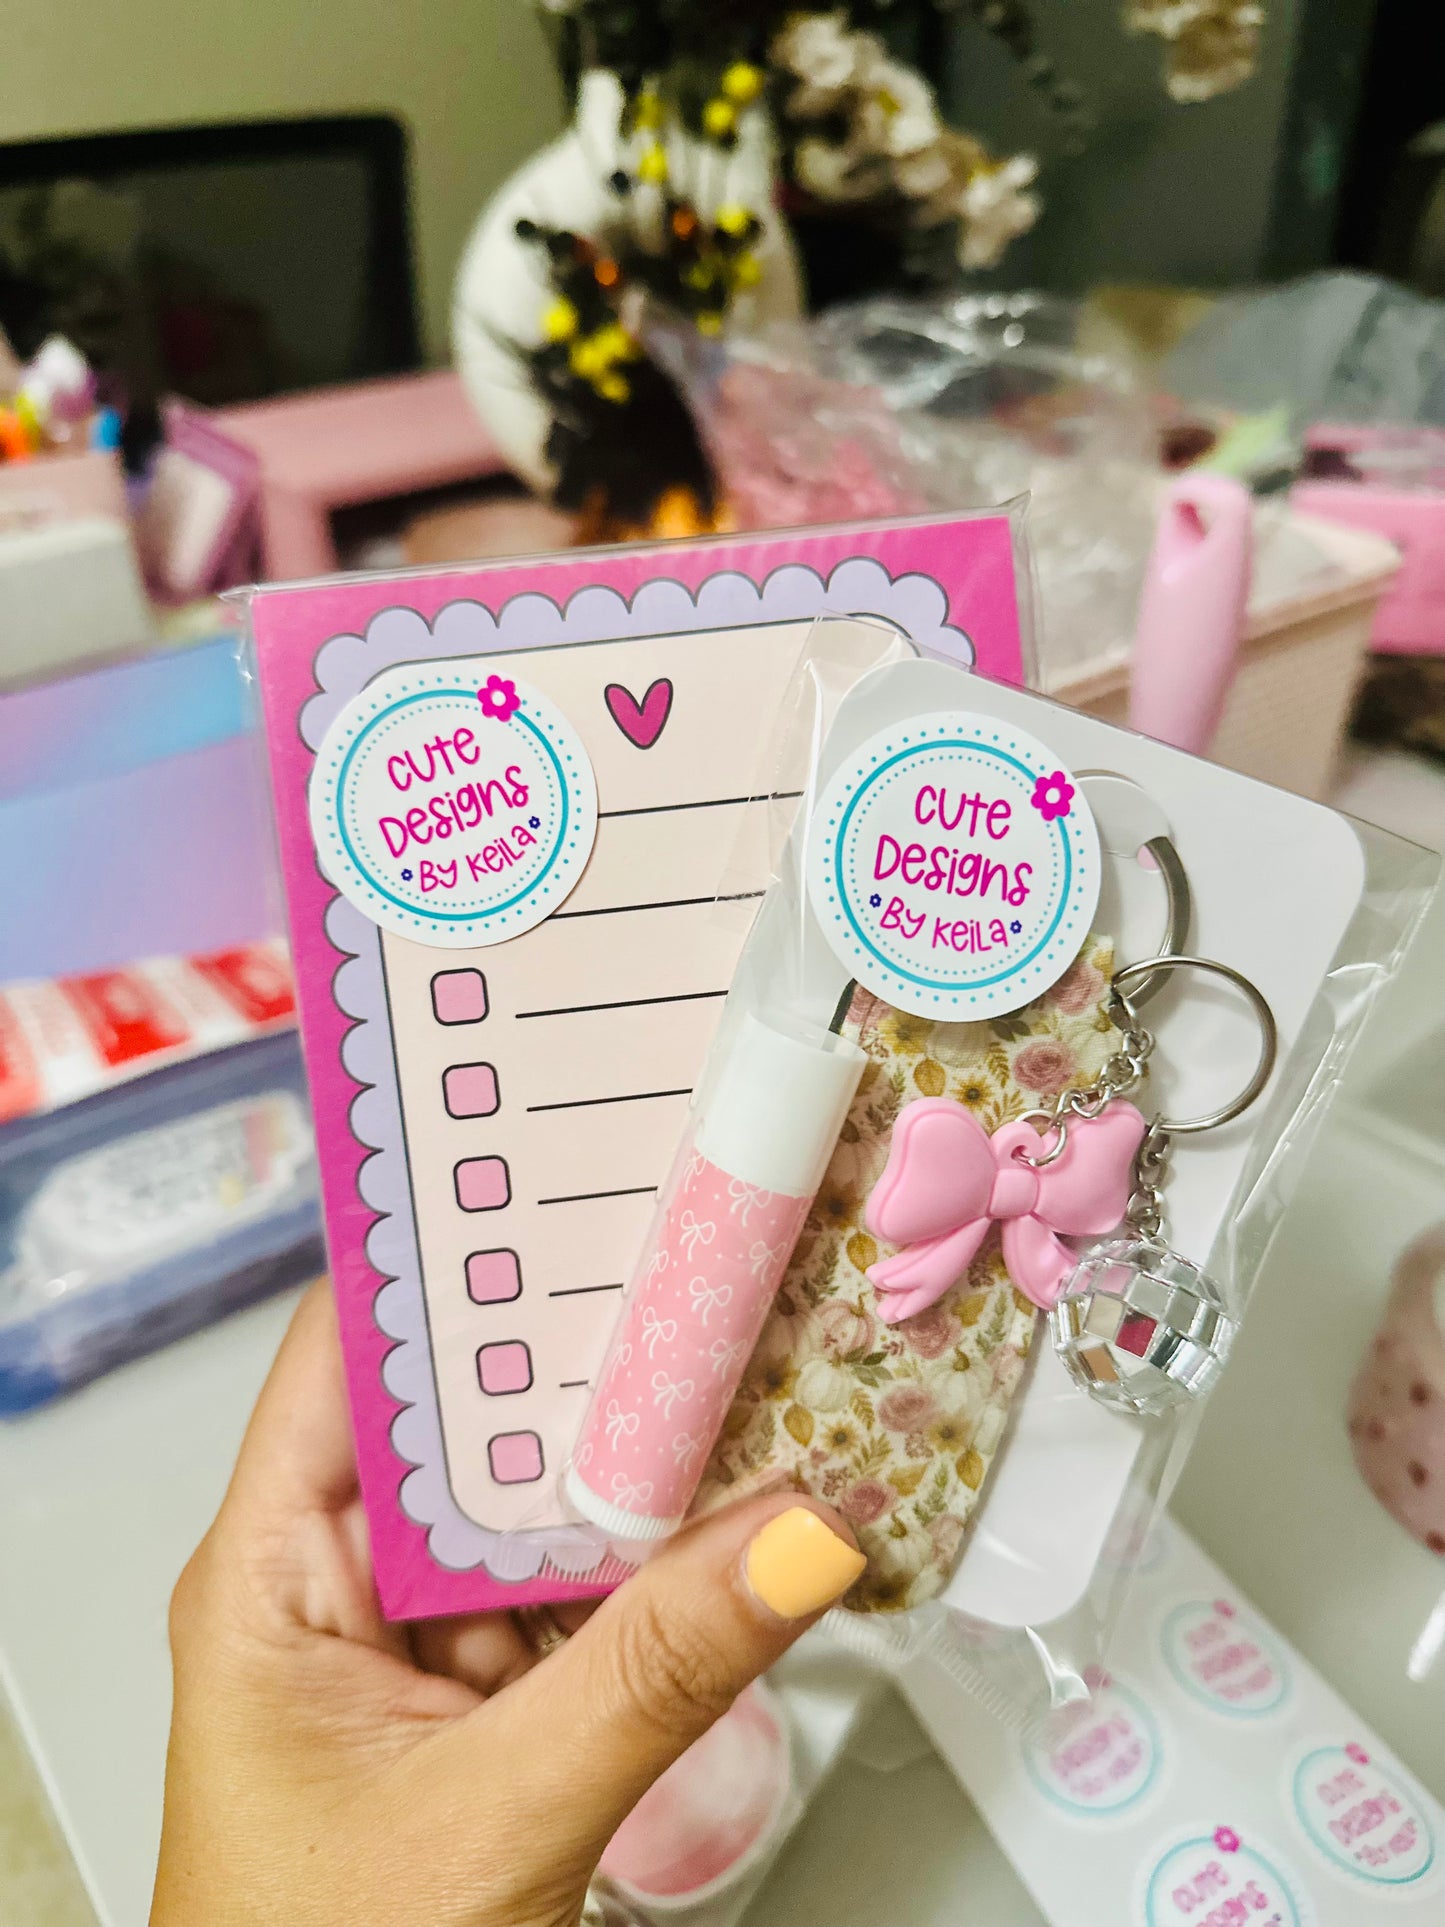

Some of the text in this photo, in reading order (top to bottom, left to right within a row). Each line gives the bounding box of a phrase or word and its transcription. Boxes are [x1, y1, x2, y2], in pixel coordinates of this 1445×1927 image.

[378, 765, 529, 859] Designs
[419, 859, 458, 893] By
[873, 833, 1033, 907] Designs
[879, 896, 927, 940] By
